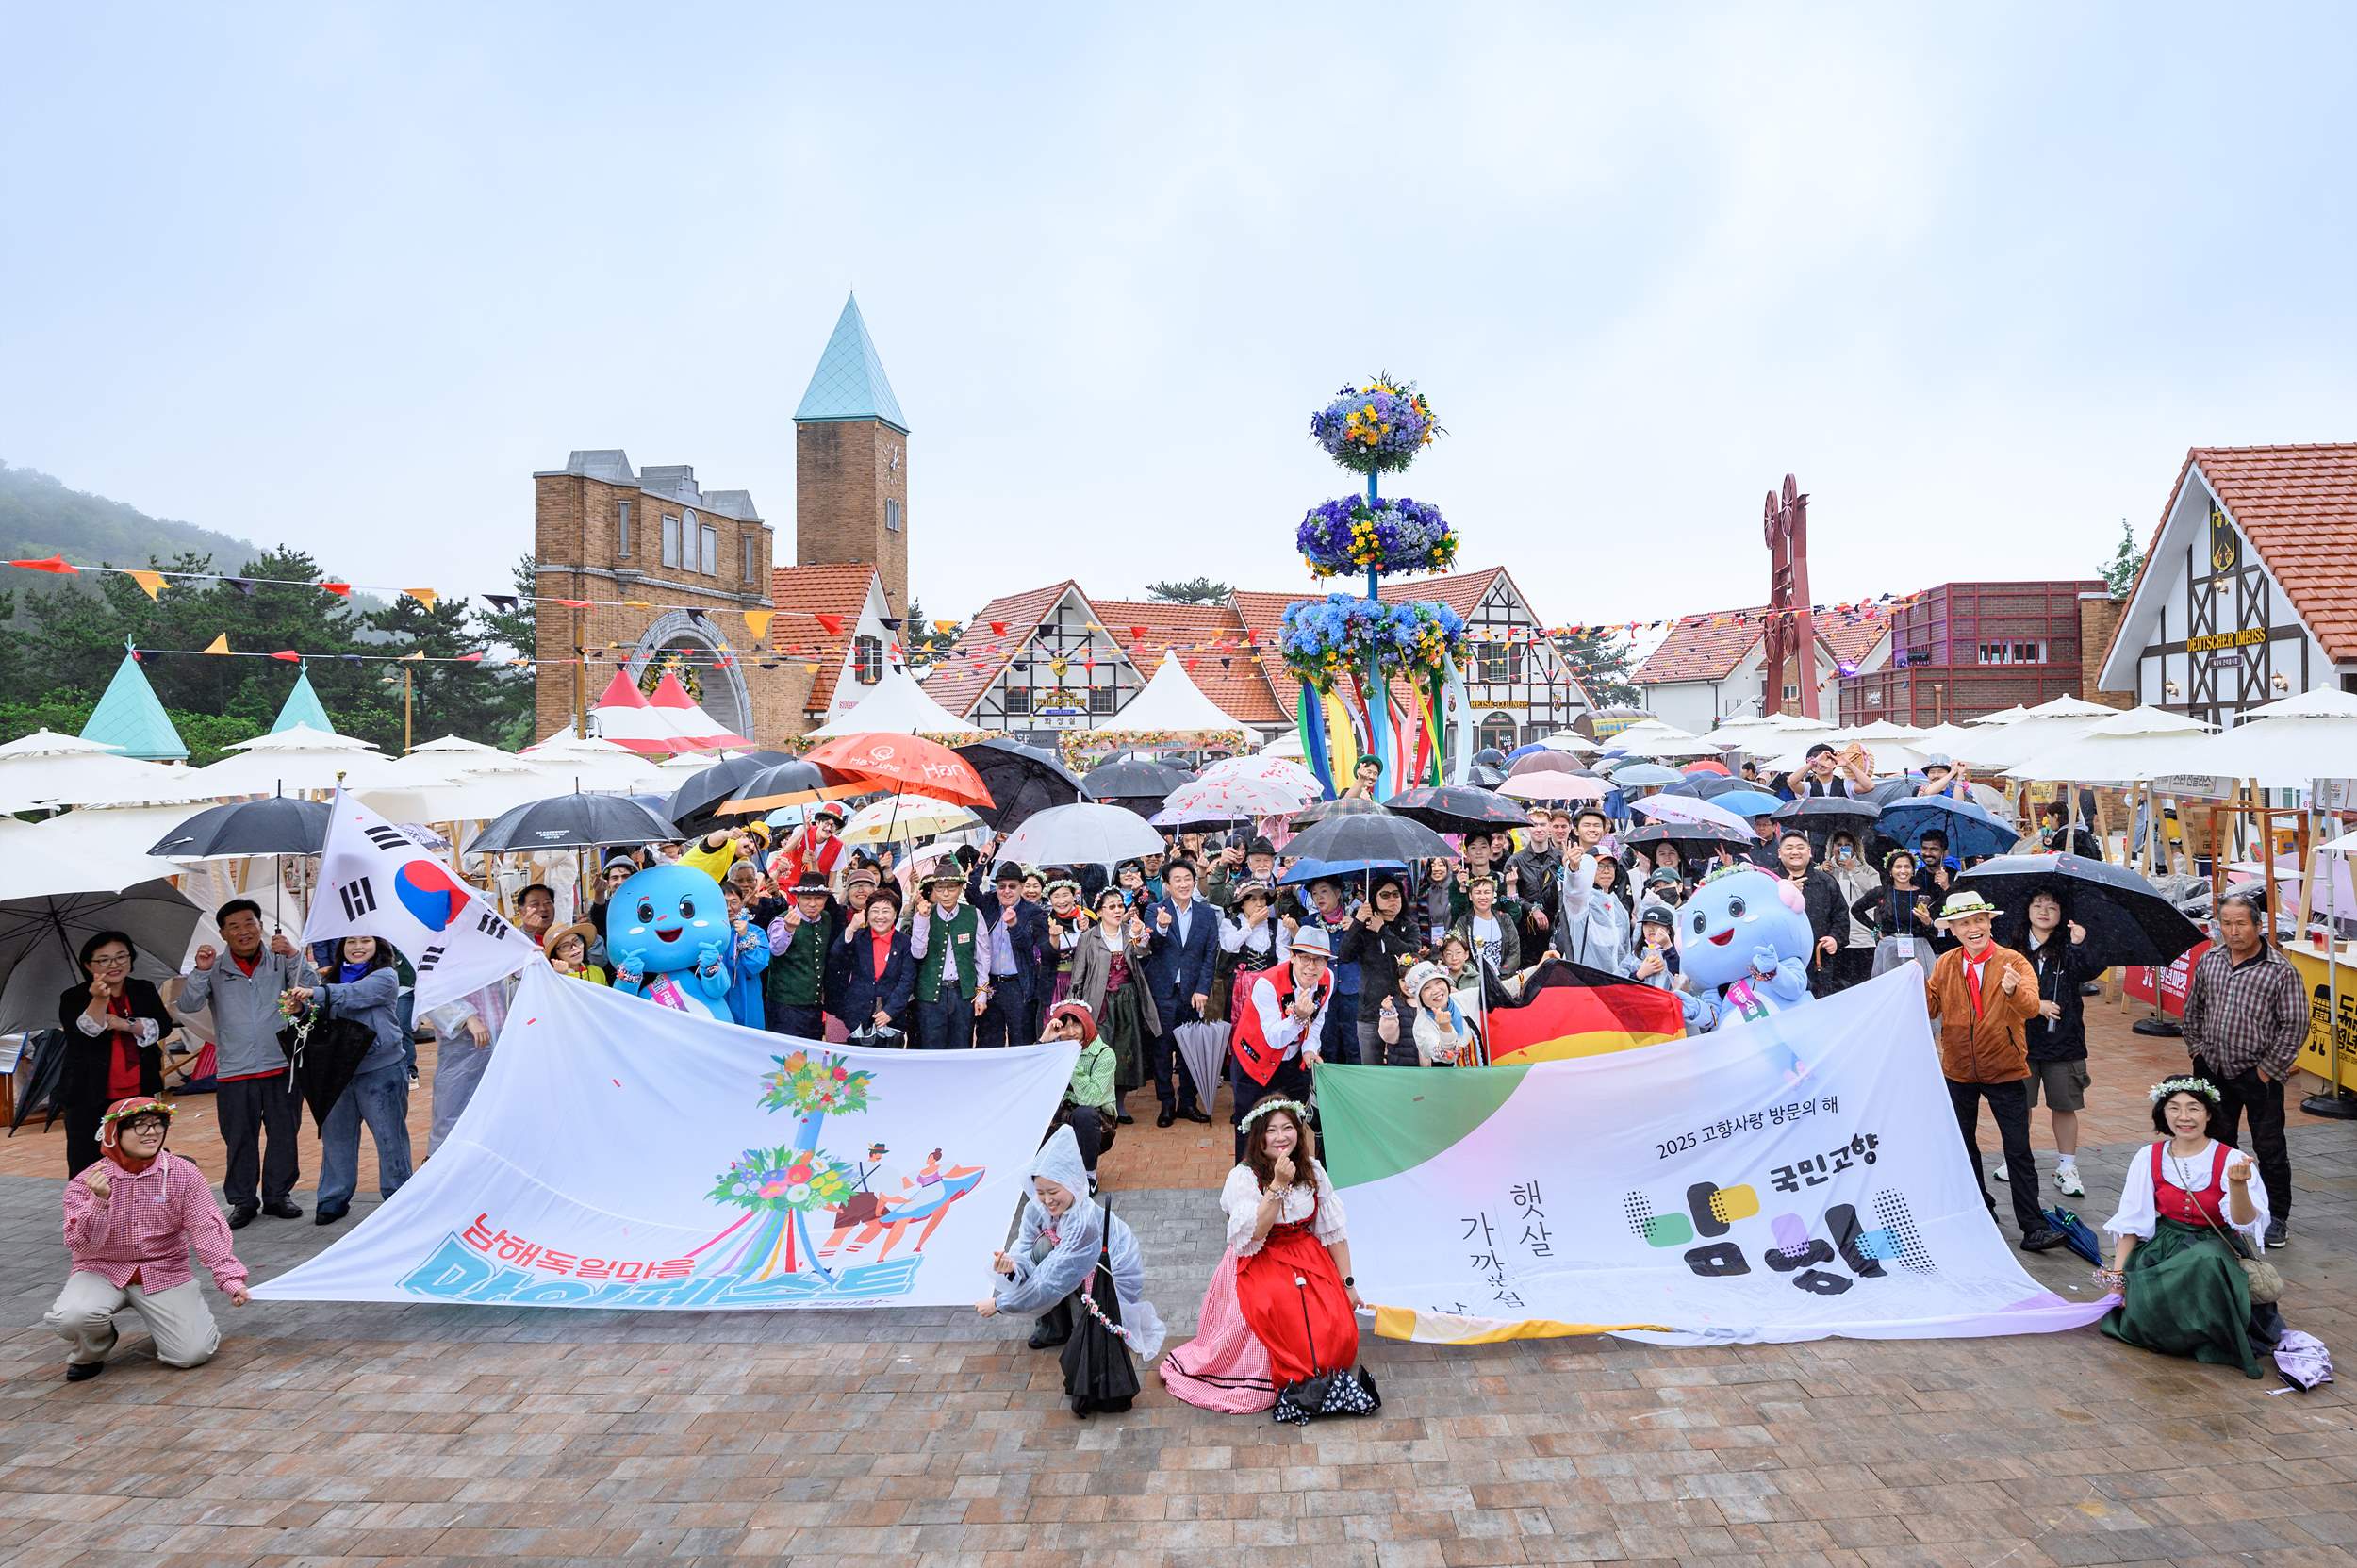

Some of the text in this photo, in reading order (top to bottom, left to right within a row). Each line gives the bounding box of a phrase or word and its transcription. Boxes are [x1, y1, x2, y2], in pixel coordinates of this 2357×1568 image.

[2187, 627, 2266, 652] DEUTSCHER IMBISS
[1034, 698, 1087, 707] TOILETTEN
[1470, 700, 1529, 709] REISE-LOUNGE
[1044, 718, 1076, 726] 화장실
[1656, 1096, 1838, 1160] 2025 고향사랑 방문의 해
[1770, 1132, 1879, 1193] 국민고향
[1509, 1180, 1555, 1257] 햇살
